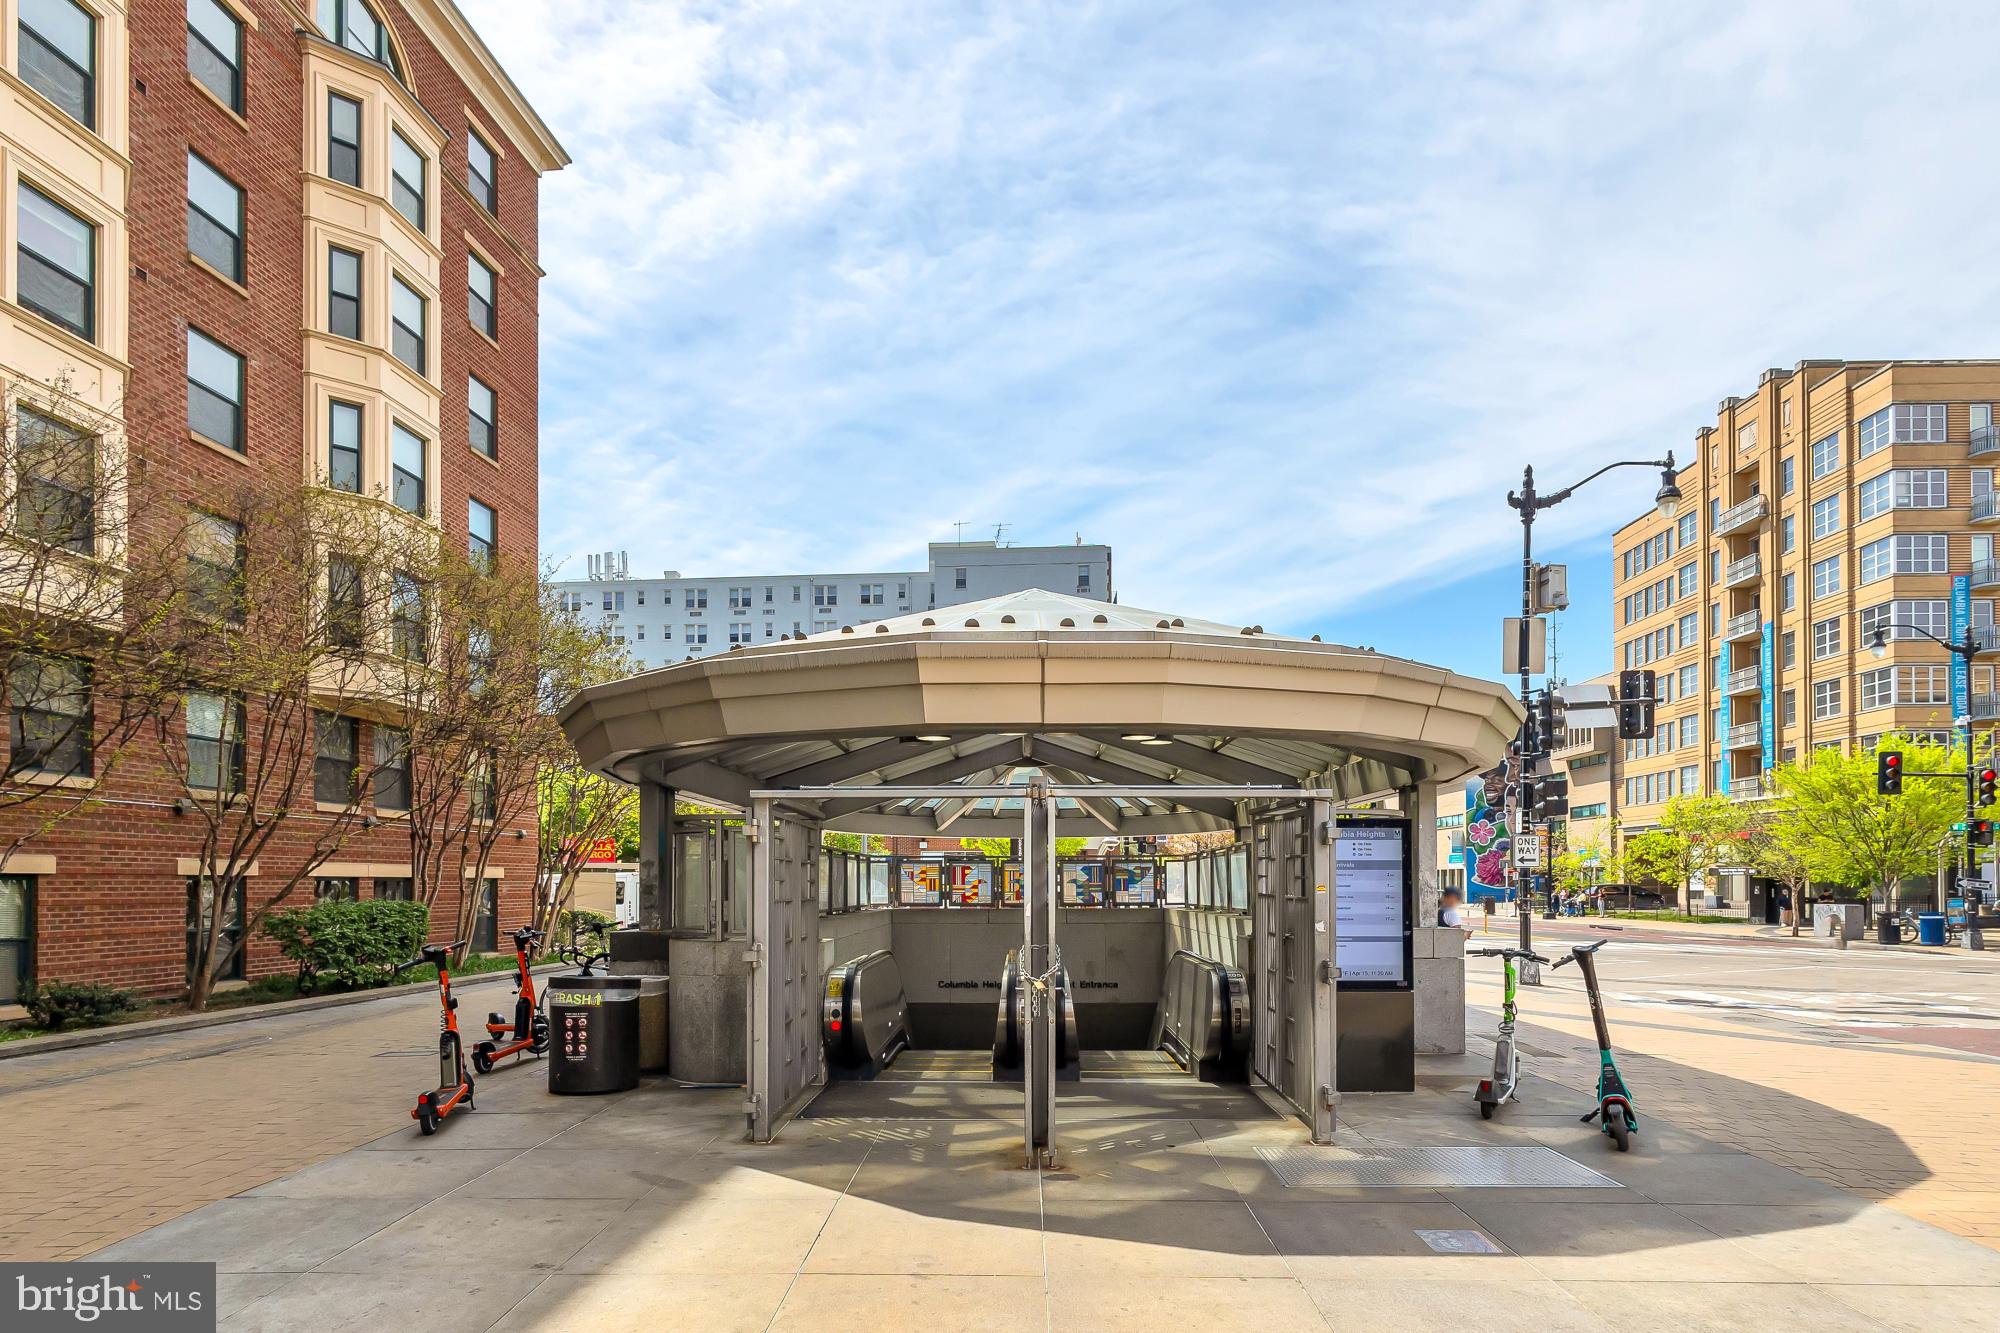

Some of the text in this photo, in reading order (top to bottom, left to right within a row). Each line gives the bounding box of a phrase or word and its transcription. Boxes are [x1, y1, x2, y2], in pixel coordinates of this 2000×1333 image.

[1954, 577, 1966, 615] COLUMBIA
[1955, 667, 1966, 689] LEASE
[1356, 830, 1386, 839] Heights
[1517, 837, 1537, 846] ONE
[1517, 846, 1538, 855] WAY
[937, 980, 979, 990] Columbia
[982, 980, 1001, 991] Heig
[1079, 980, 1119, 990] Entrance
[554, 992, 591, 1006] TRASH
